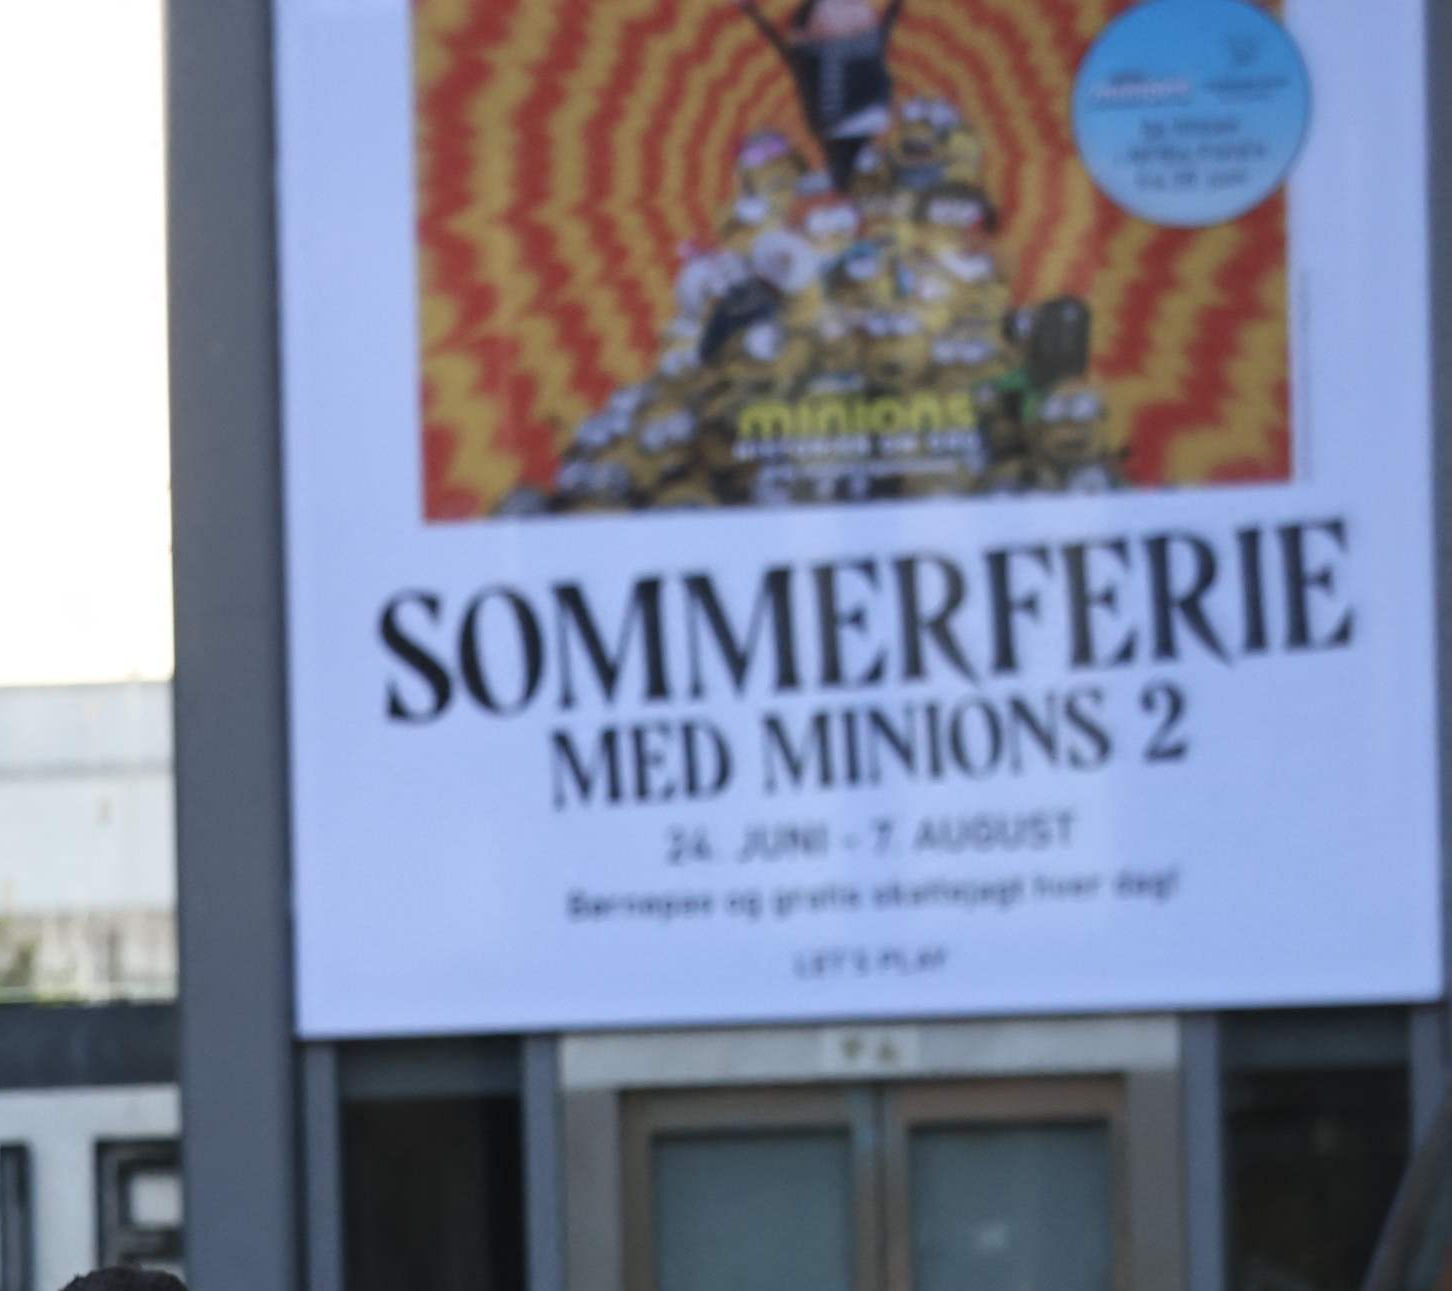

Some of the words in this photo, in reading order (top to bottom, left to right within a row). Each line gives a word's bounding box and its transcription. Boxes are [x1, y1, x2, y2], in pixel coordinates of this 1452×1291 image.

[377, 516, 1356, 725] SOMMERFERIE
[551, 719, 734, 811] MED
[762, 689, 1113, 796] MINIONS
[1142, 684, 1188, 764] 2
[736, 818, 828, 864] JUNI
[912, 806, 1077, 855] AUGUST
